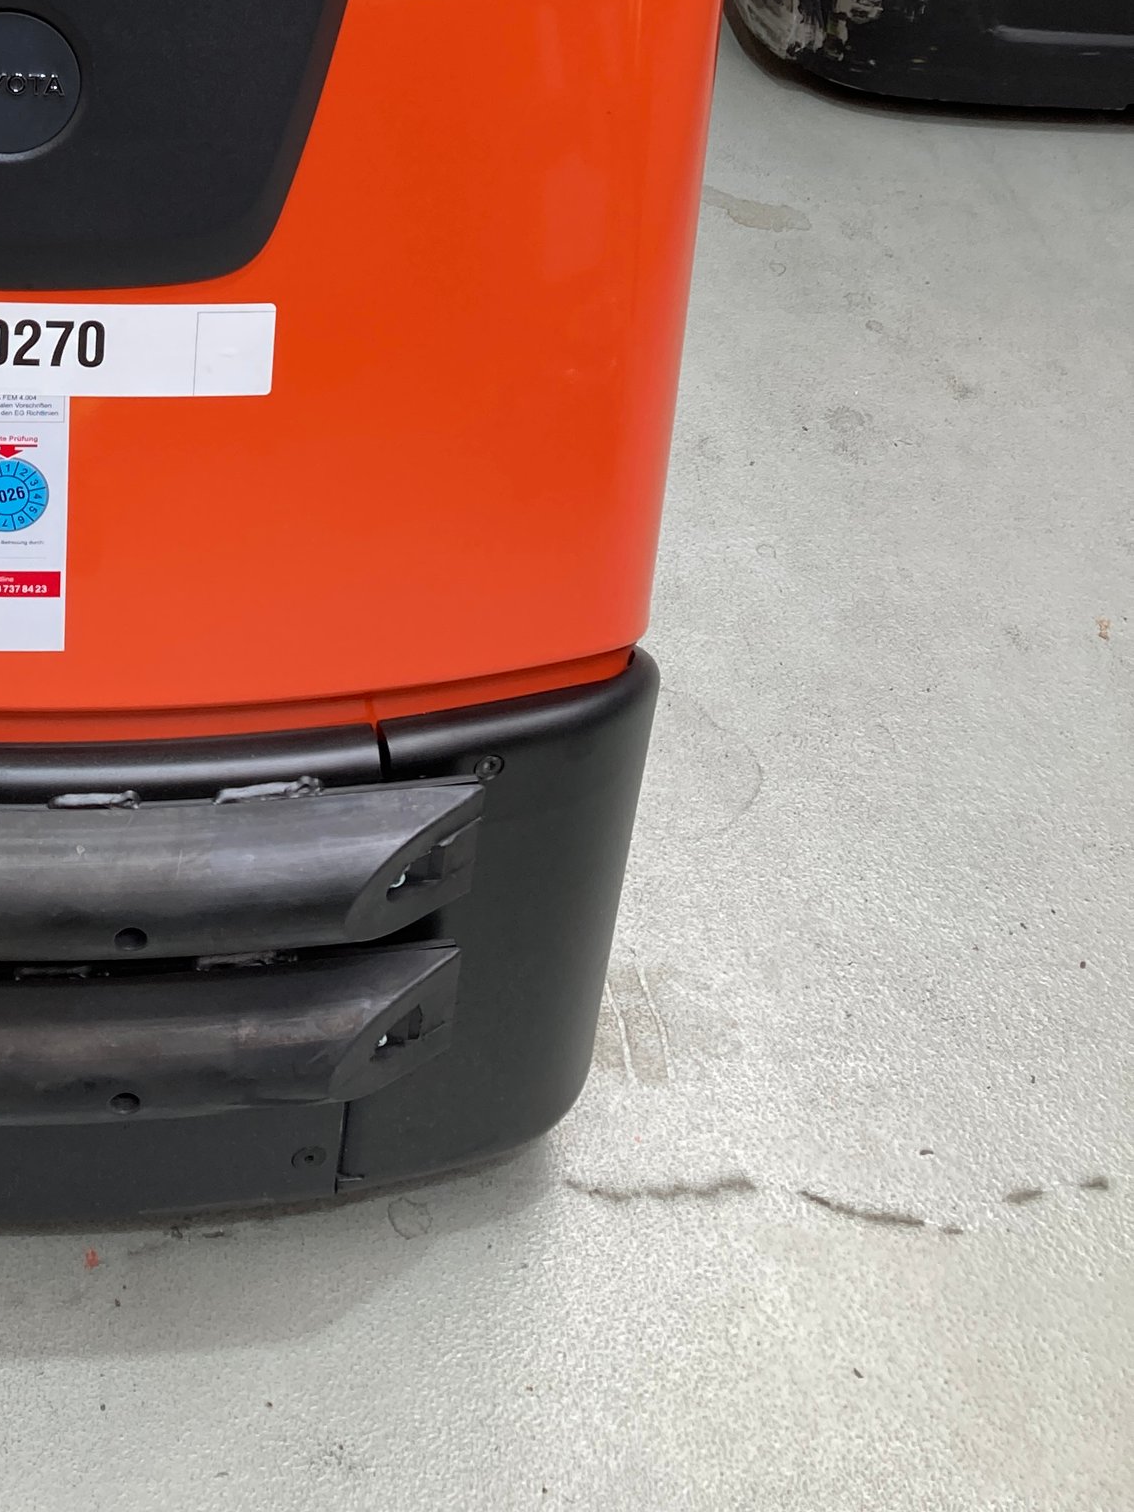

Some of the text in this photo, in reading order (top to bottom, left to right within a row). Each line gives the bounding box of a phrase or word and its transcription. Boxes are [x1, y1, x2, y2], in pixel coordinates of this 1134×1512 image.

[9, 435, 38, 443] Prüfung
[6, 464, 10, 472] 1
[19, 468, 28, 477] 2
[29, 506, 38, 514] 5
[3, 584, 20, 593] 737
[22, 585, 34, 593] 84
[35, 585, 47, 593] 23
